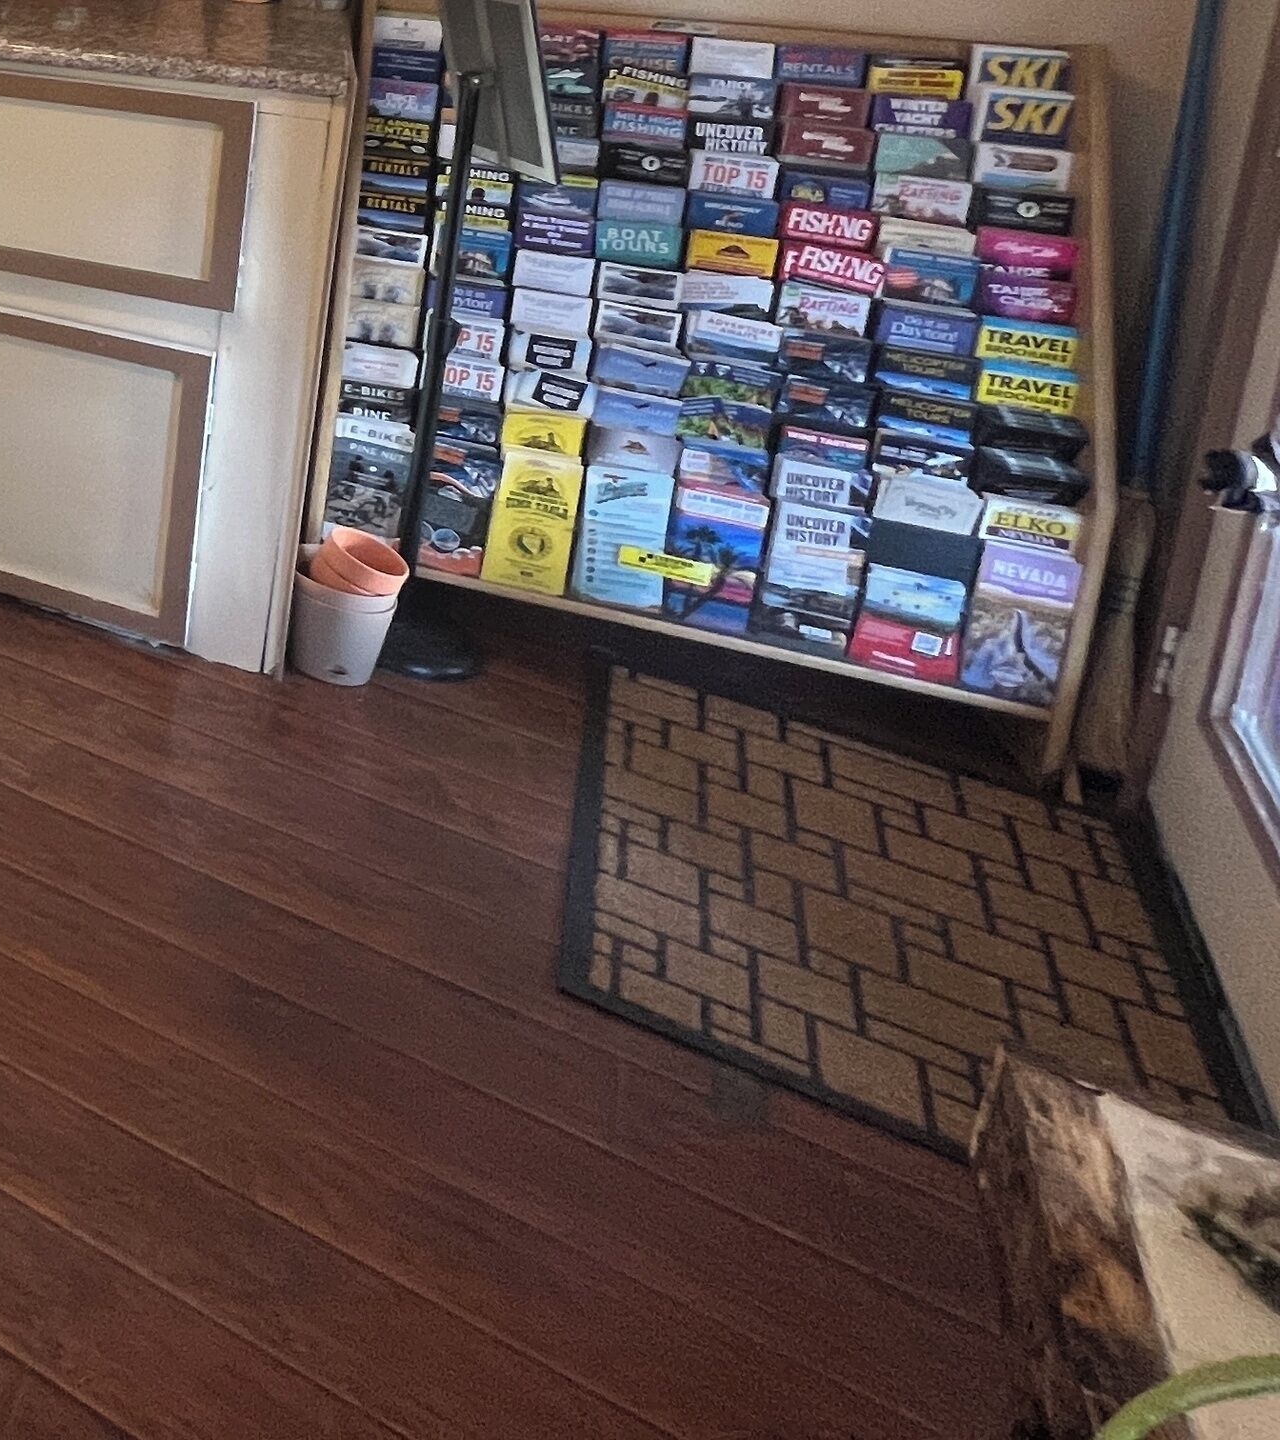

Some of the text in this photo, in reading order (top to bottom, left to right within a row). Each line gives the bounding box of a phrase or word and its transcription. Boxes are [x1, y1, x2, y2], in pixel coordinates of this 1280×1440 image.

[622, 66, 688, 90] FISHING
[781, 62, 856, 75] RENTALS
[986, 55, 1062, 90] SKI
[890, 98, 948, 113] WINTER
[987, 96, 1072, 135] SKI
[895, 111, 942, 125] YACHT
[612, 121, 682, 137] FISHING
[695, 122, 764, 141] UNCOVER
[704, 138, 768, 155] HISTORY
[704, 163, 740, 184] TOP
[746, 170, 769, 190] 15
[899, 185, 962, 203] RAFTING
[607, 228, 662, 242] BOAT
[599, 238, 670, 255] TOURS
[799, 298, 860, 317] RAFTING
[707, 317, 775, 339] ADVENTURE
[891, 321, 959, 343] Dayton!
[986, 329, 1072, 353] TRAVEL
[985, 344, 1070, 364] BROCHURES
[476, 370, 495, 391] 15
[987, 372, 1074, 399] TRAVEL
[344, 382, 406, 402] E-BIKES
[985, 388, 1070, 410] BROCHURES
[352, 406, 392, 422] PINE
[890, 396, 972, 418] HELICOPTER
[906, 408, 951, 424] TOURS
[350, 424, 414, 447] E-BIKES
[349, 442, 379, 456] PINE
[786, 471, 845, 492] UNCOVER
[785, 486, 839, 505] HISTORY
[786, 513, 846, 534] UNCOVER
[995, 510, 1067, 536] ELKO
[785, 529, 840, 547] HISTORY
[992, 557, 1068, 589] NEVADA
